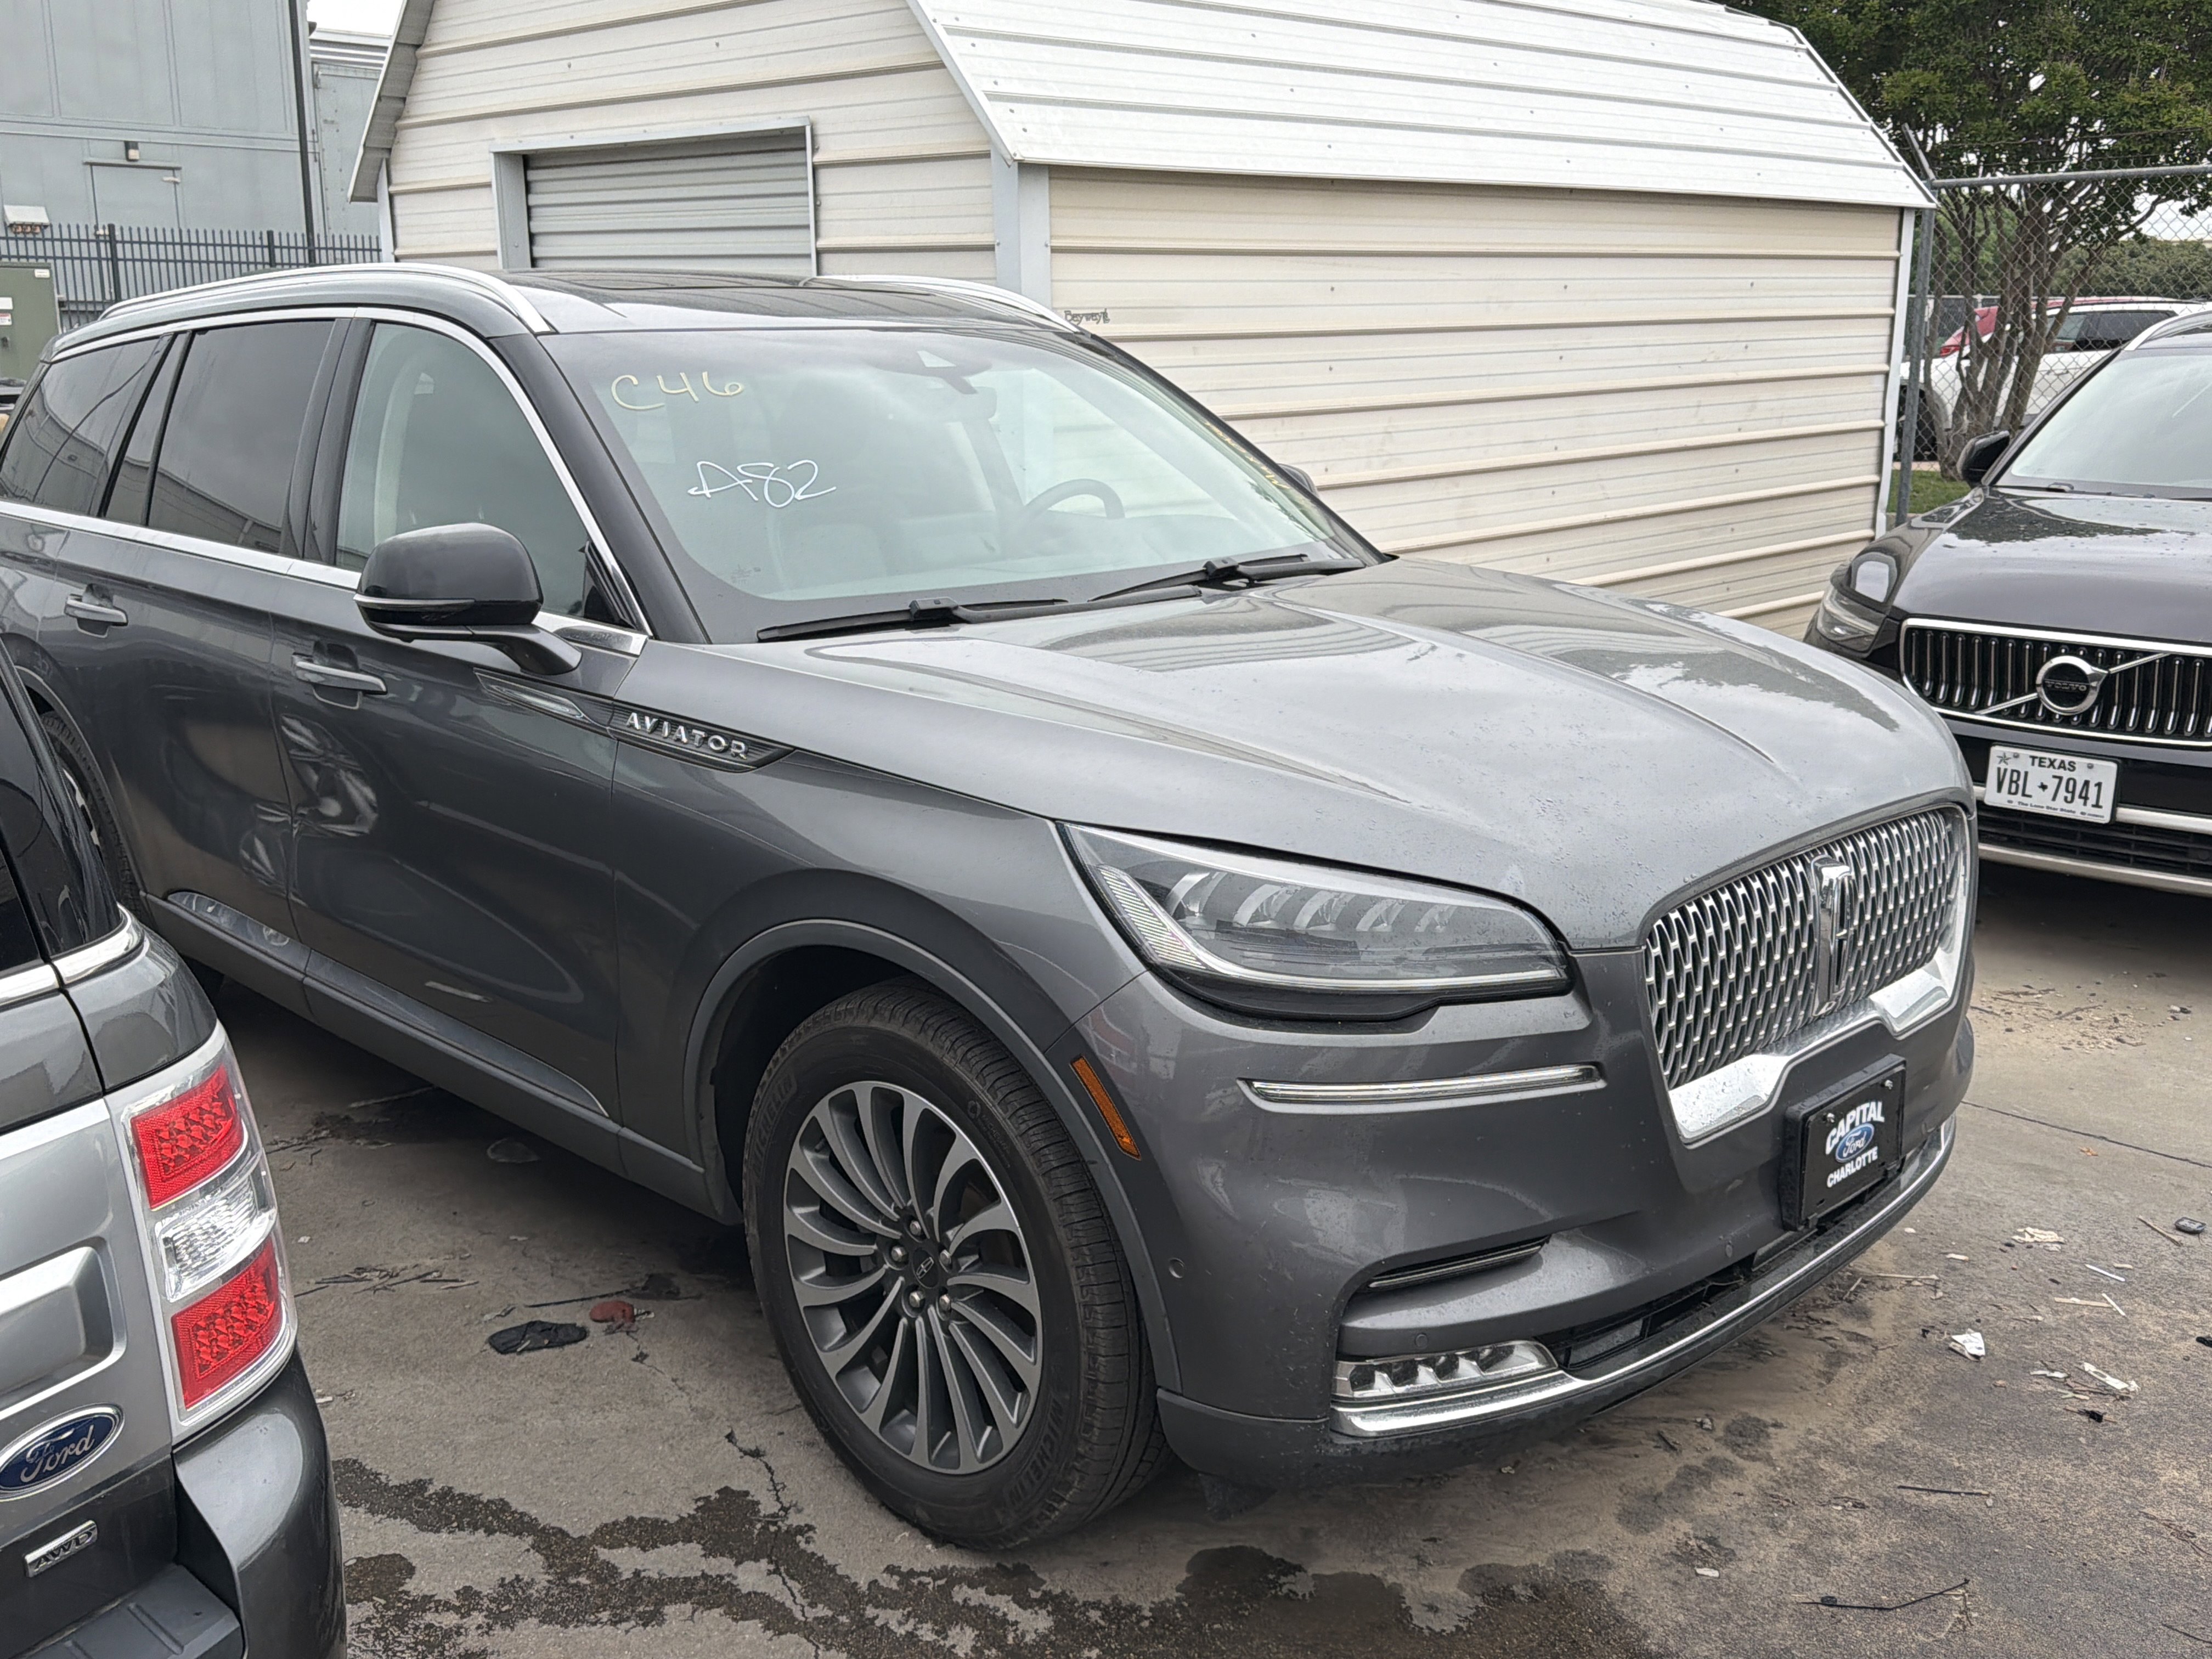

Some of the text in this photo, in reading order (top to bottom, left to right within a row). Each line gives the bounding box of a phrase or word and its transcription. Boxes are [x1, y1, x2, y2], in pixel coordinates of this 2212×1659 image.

[611, 371, 744, 410] C46
[688, 460, 837, 508] A82
[2044, 680, 2087, 692] VOLVO
[626, 712, 749, 760] AVIATOR
[2029, 755, 2077, 772] TEXAS
[1996, 766, 2103, 809] VBL 7941
[1825, 1101, 1885, 1155] CAPITAL
[1843, 1130, 1867, 1158] Ford
[1826, 1146, 1878, 1188] CHARLOTTE
[20, 1424, 95, 1483] Ford
[33, 1530, 93, 1571] AWD
